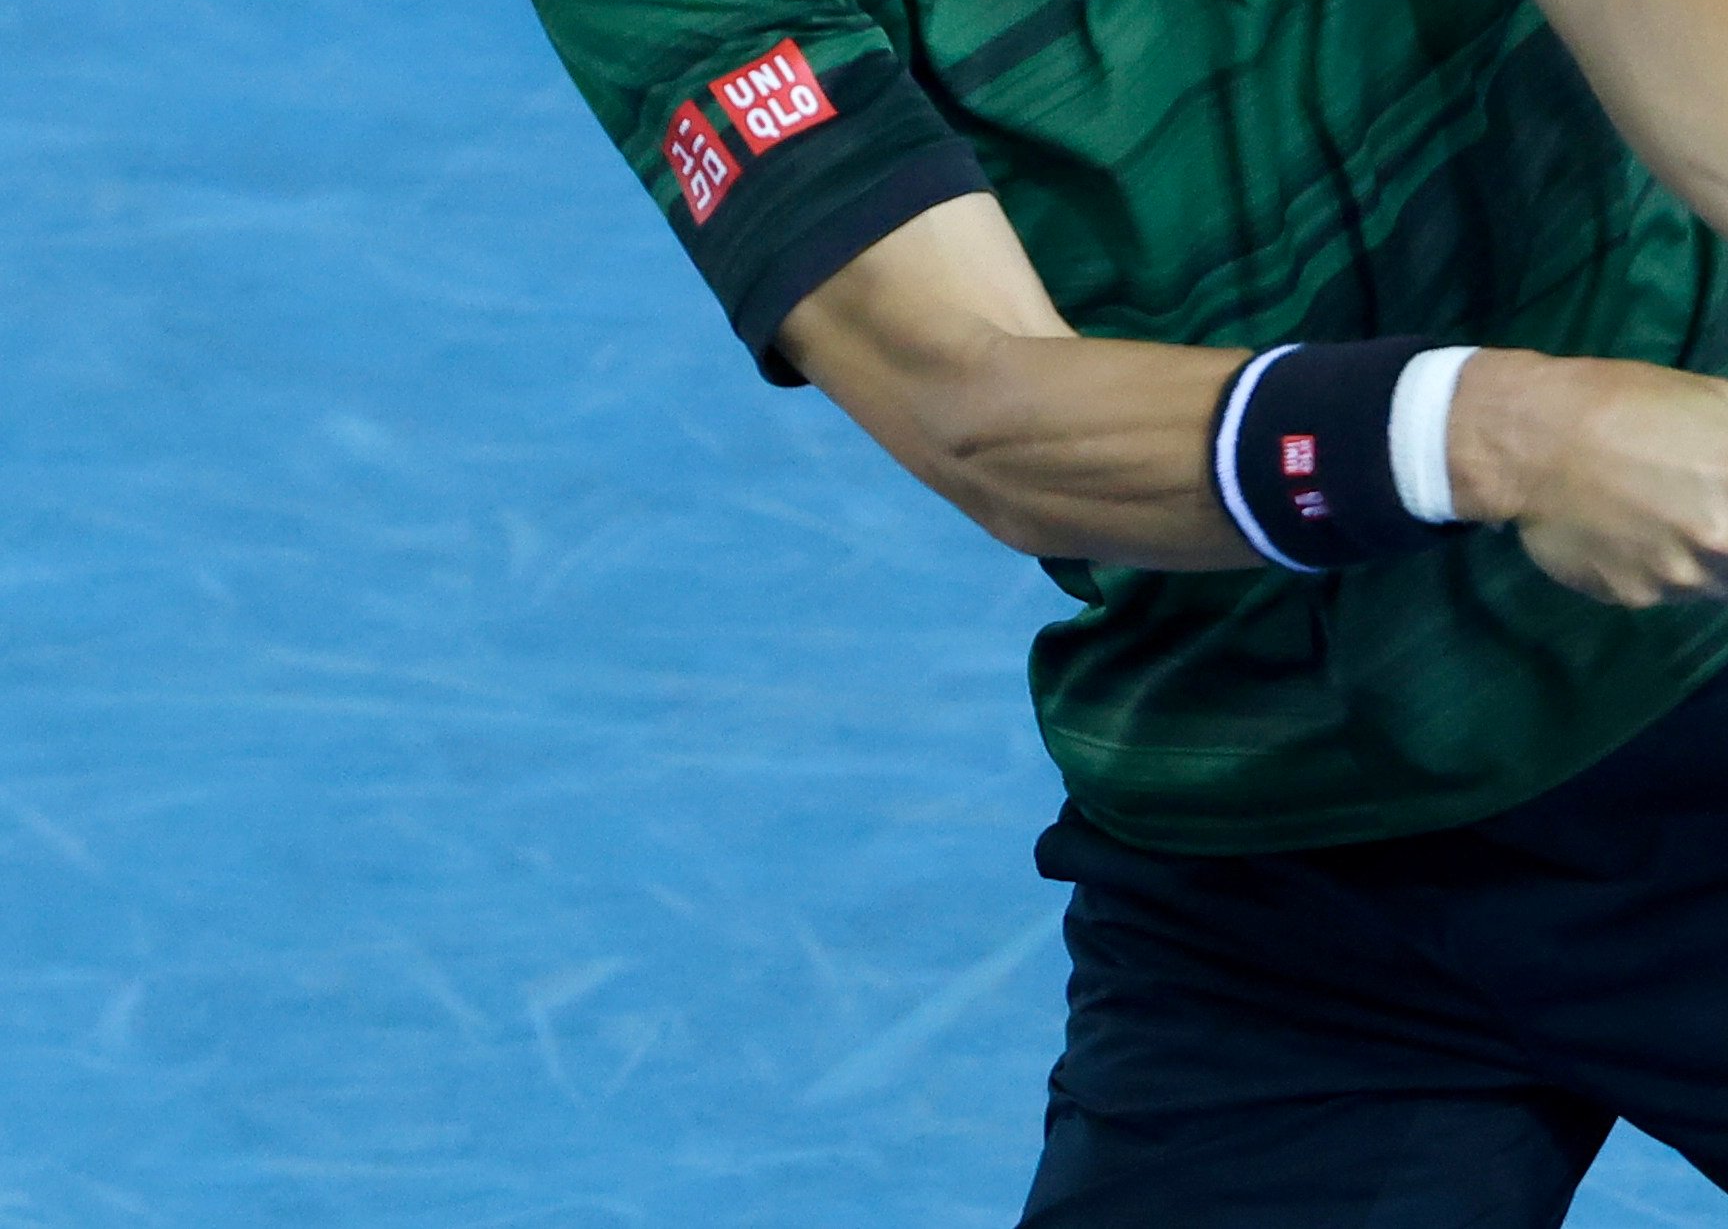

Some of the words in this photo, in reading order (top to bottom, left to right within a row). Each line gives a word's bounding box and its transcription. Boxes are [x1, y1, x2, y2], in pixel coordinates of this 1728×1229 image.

[723, 54, 796, 109] UNI
[746, 85, 819, 139] QLO
[671, 118, 706, 176] ユニ
[690, 147, 728, 211] クロ
